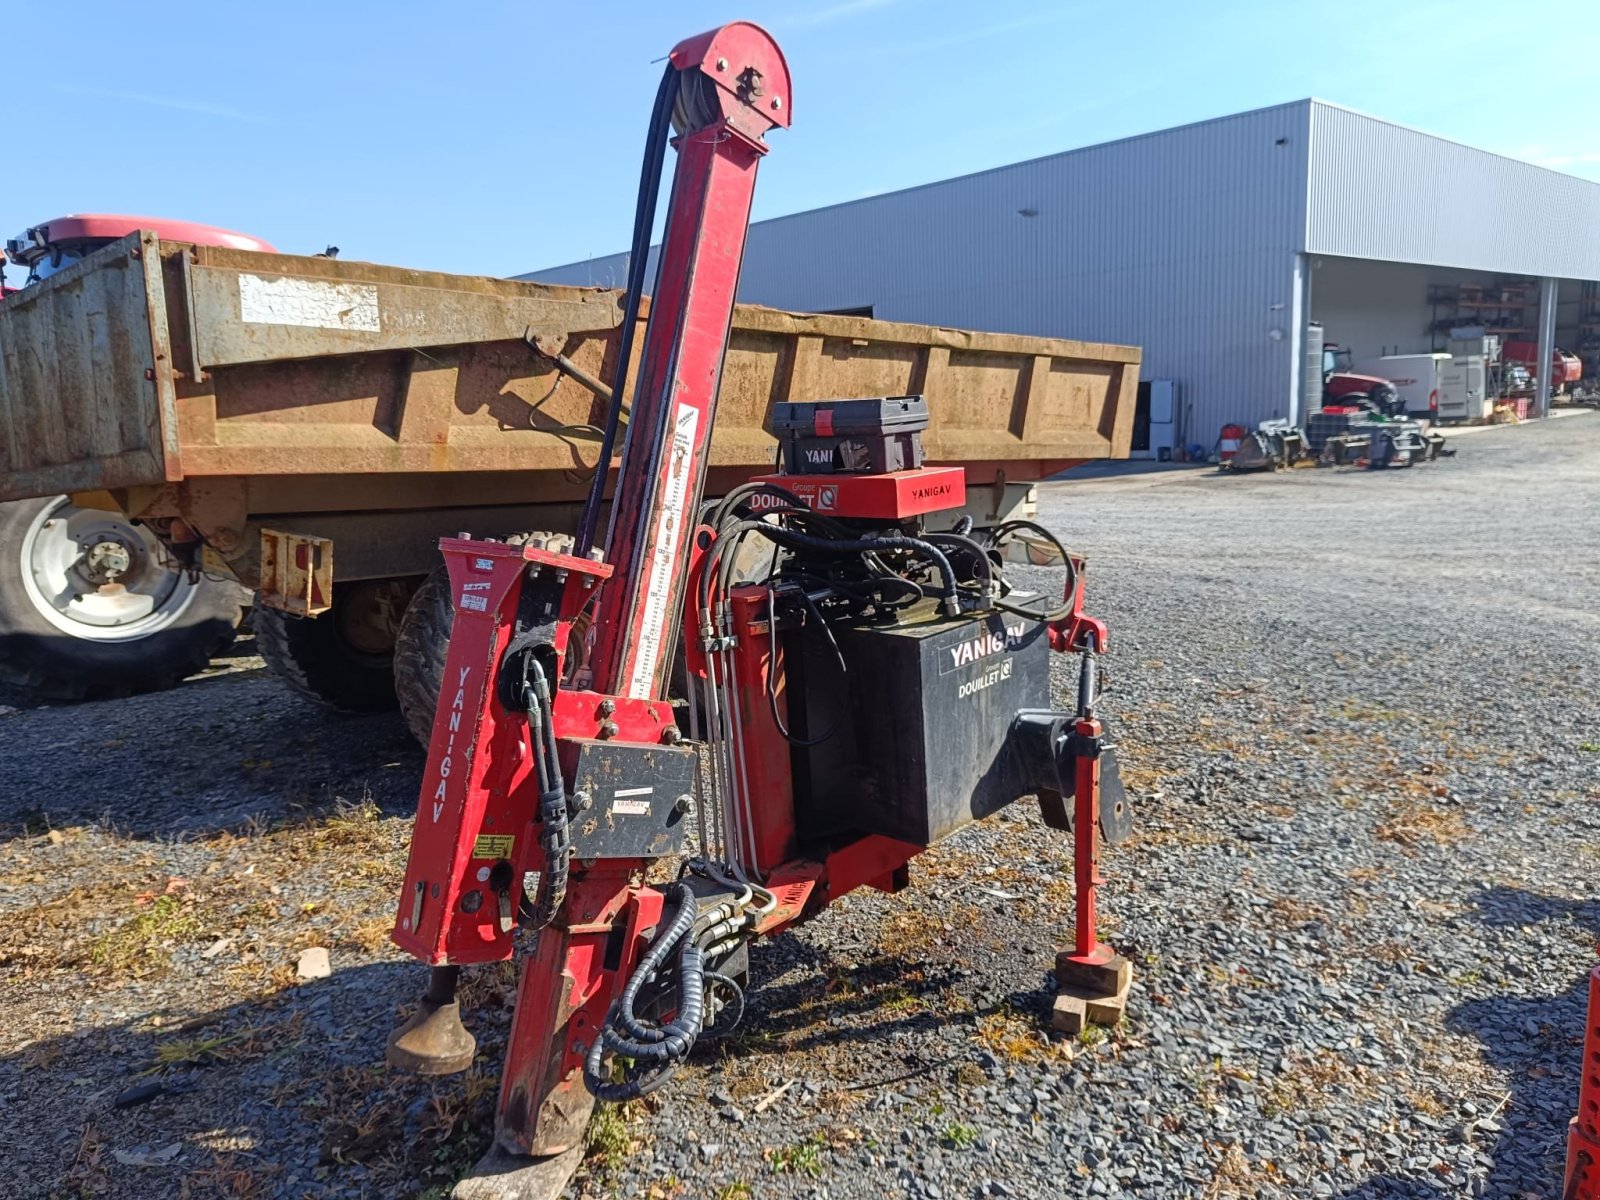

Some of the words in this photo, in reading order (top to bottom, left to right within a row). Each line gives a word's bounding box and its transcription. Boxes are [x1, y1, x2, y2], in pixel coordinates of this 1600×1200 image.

[792, 483, 816, 493] Groupe
[912, 484, 952, 500] YANIGAV
[951, 622, 1025, 668] YANIGAV
[958, 670, 1001, 699] DOUILLET
[432, 666, 471, 824] YANIGAV
